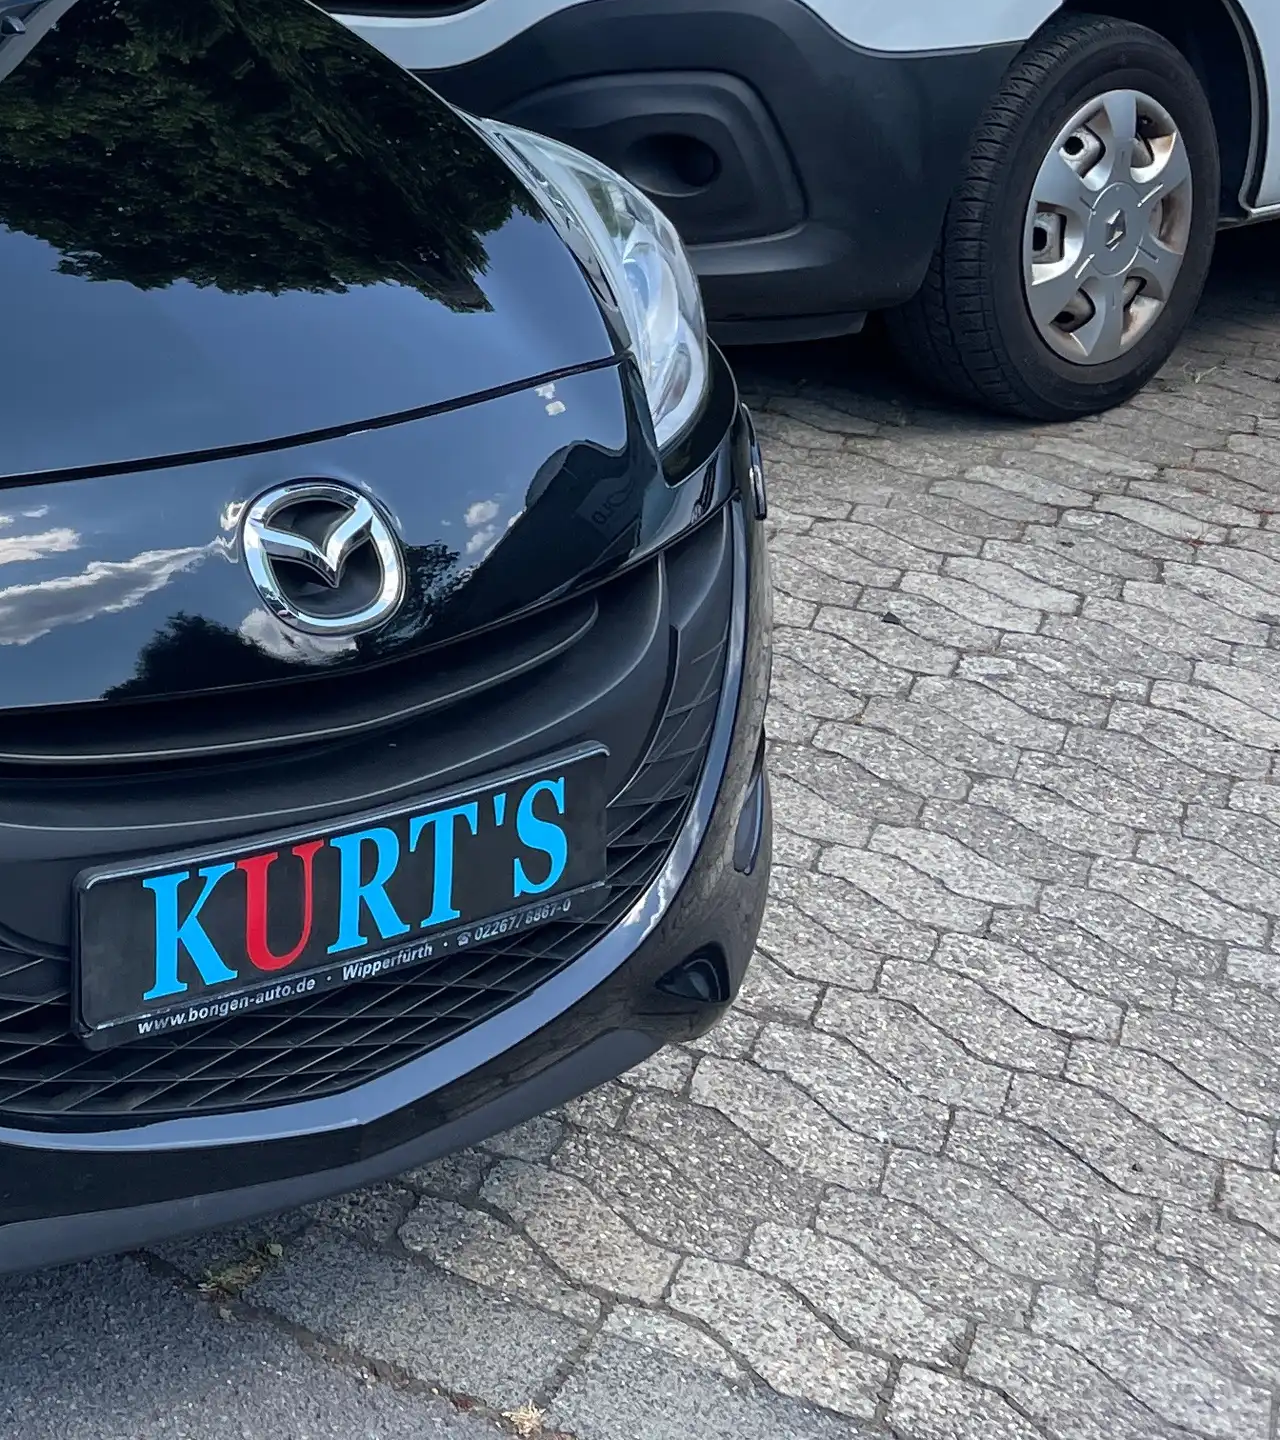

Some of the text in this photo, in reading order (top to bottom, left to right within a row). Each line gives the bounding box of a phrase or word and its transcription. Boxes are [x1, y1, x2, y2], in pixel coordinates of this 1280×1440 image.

[142, 776, 568, 1001] KURT'S
[137, 977, 316, 1034] www.bongen-auto.de
[342, 943, 433, 981] Wipperfürth
